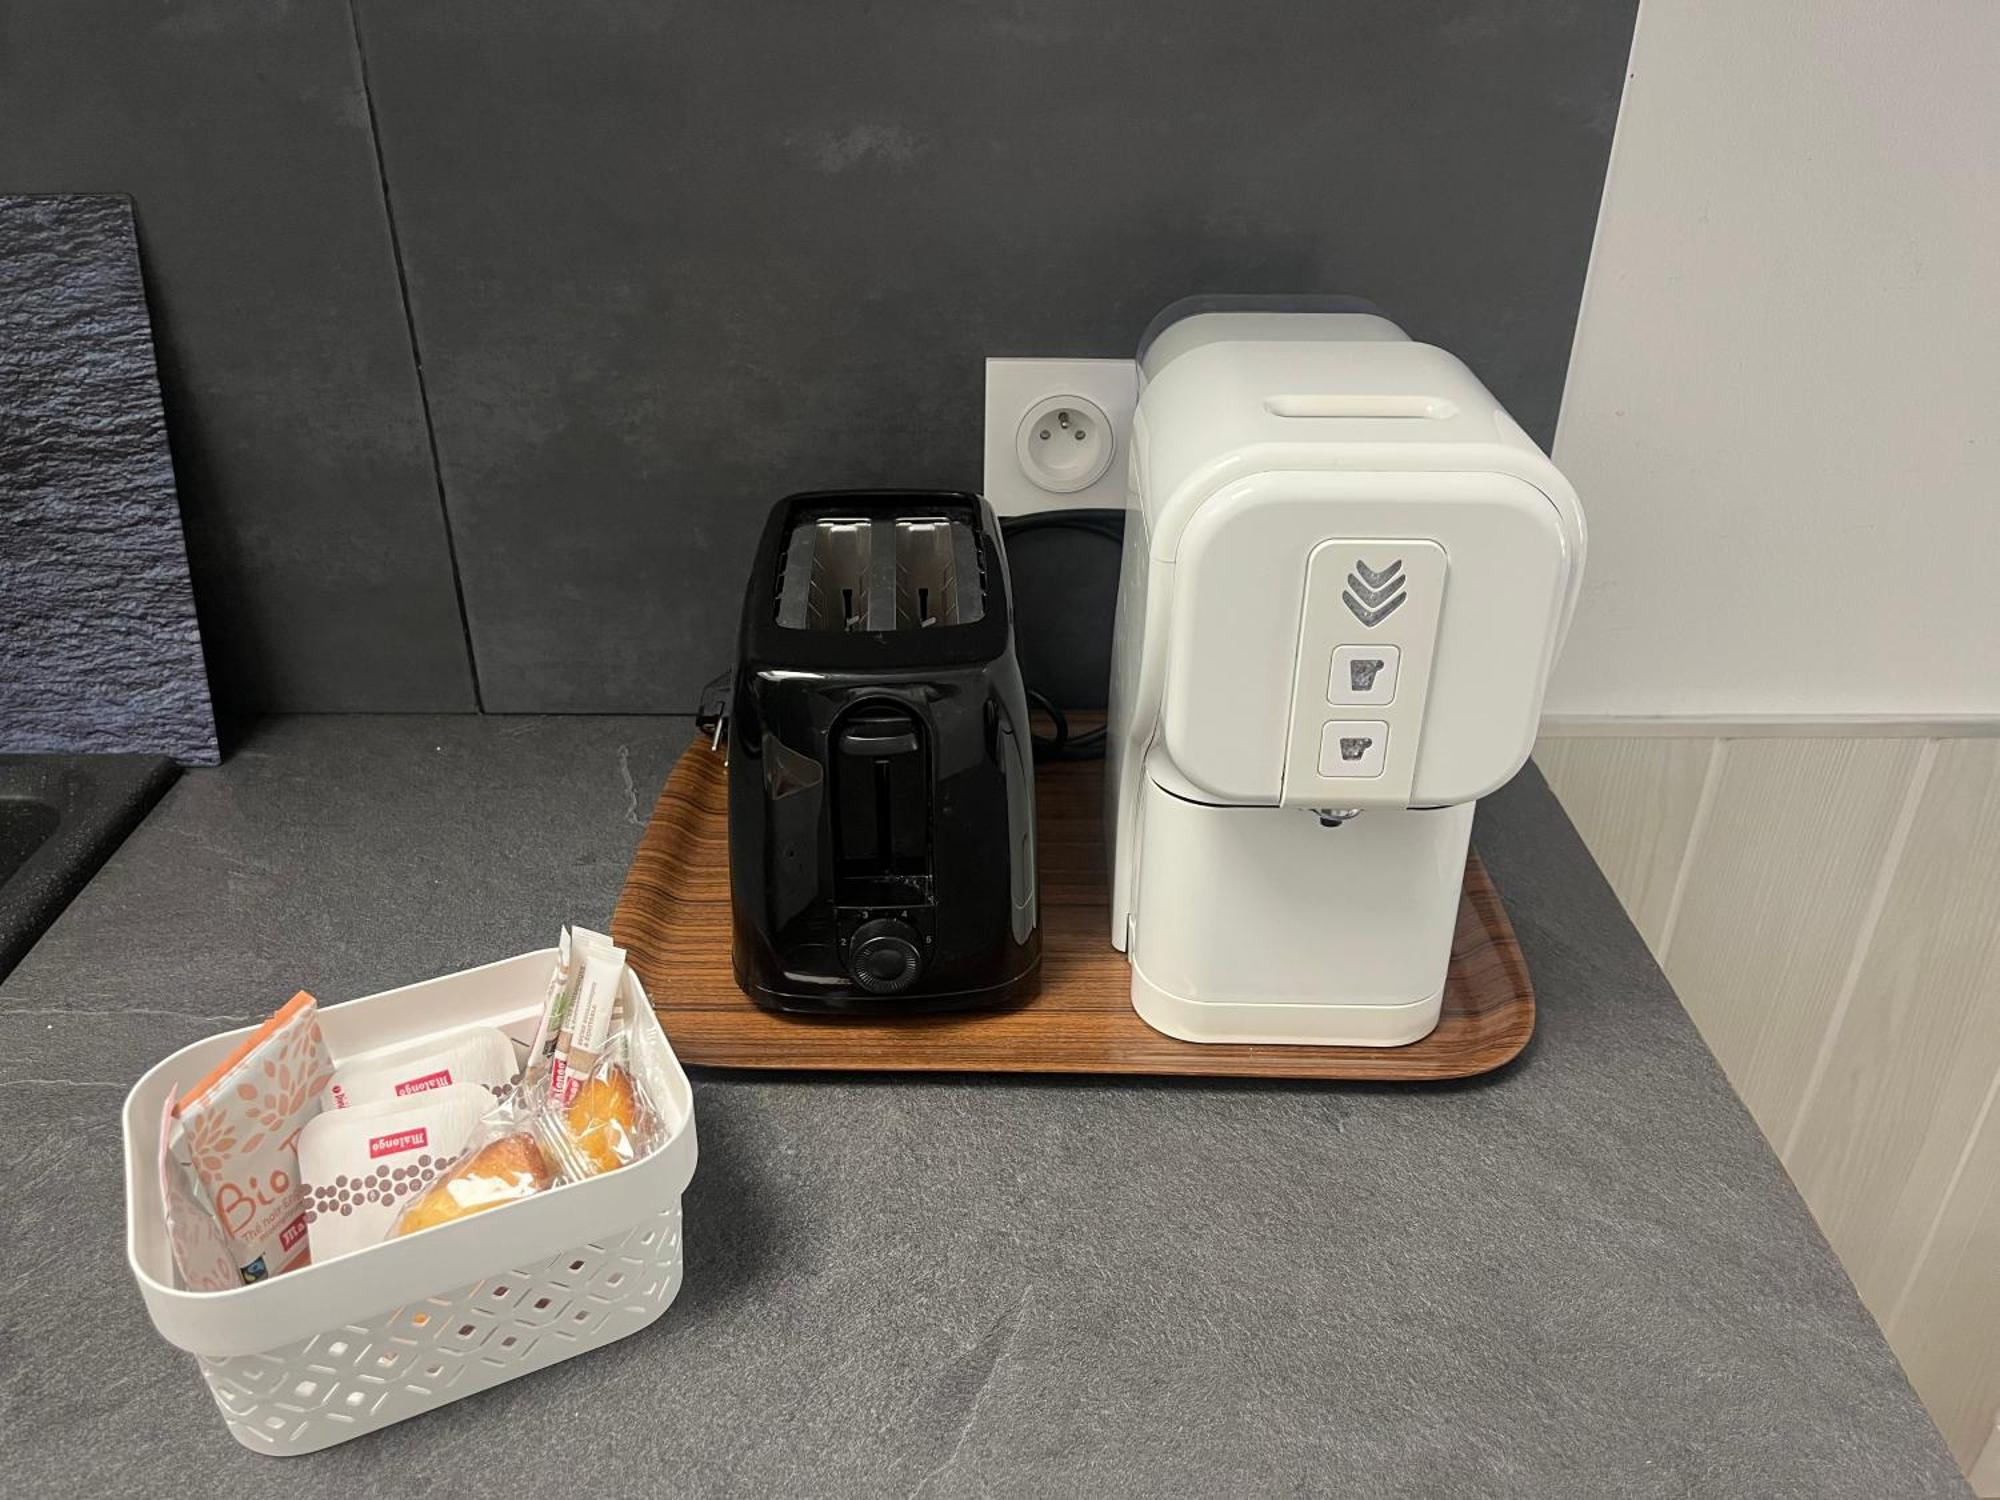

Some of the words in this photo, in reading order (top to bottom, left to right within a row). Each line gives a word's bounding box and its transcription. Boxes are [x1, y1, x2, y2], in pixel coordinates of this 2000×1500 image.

[901, 910, 908, 918] 4
[840, 938, 847, 946] 2
[399, 1075, 449, 1096] Malongo
[372, 1133, 424, 1151] Malongo
[216, 1170, 289, 1239] Bio
